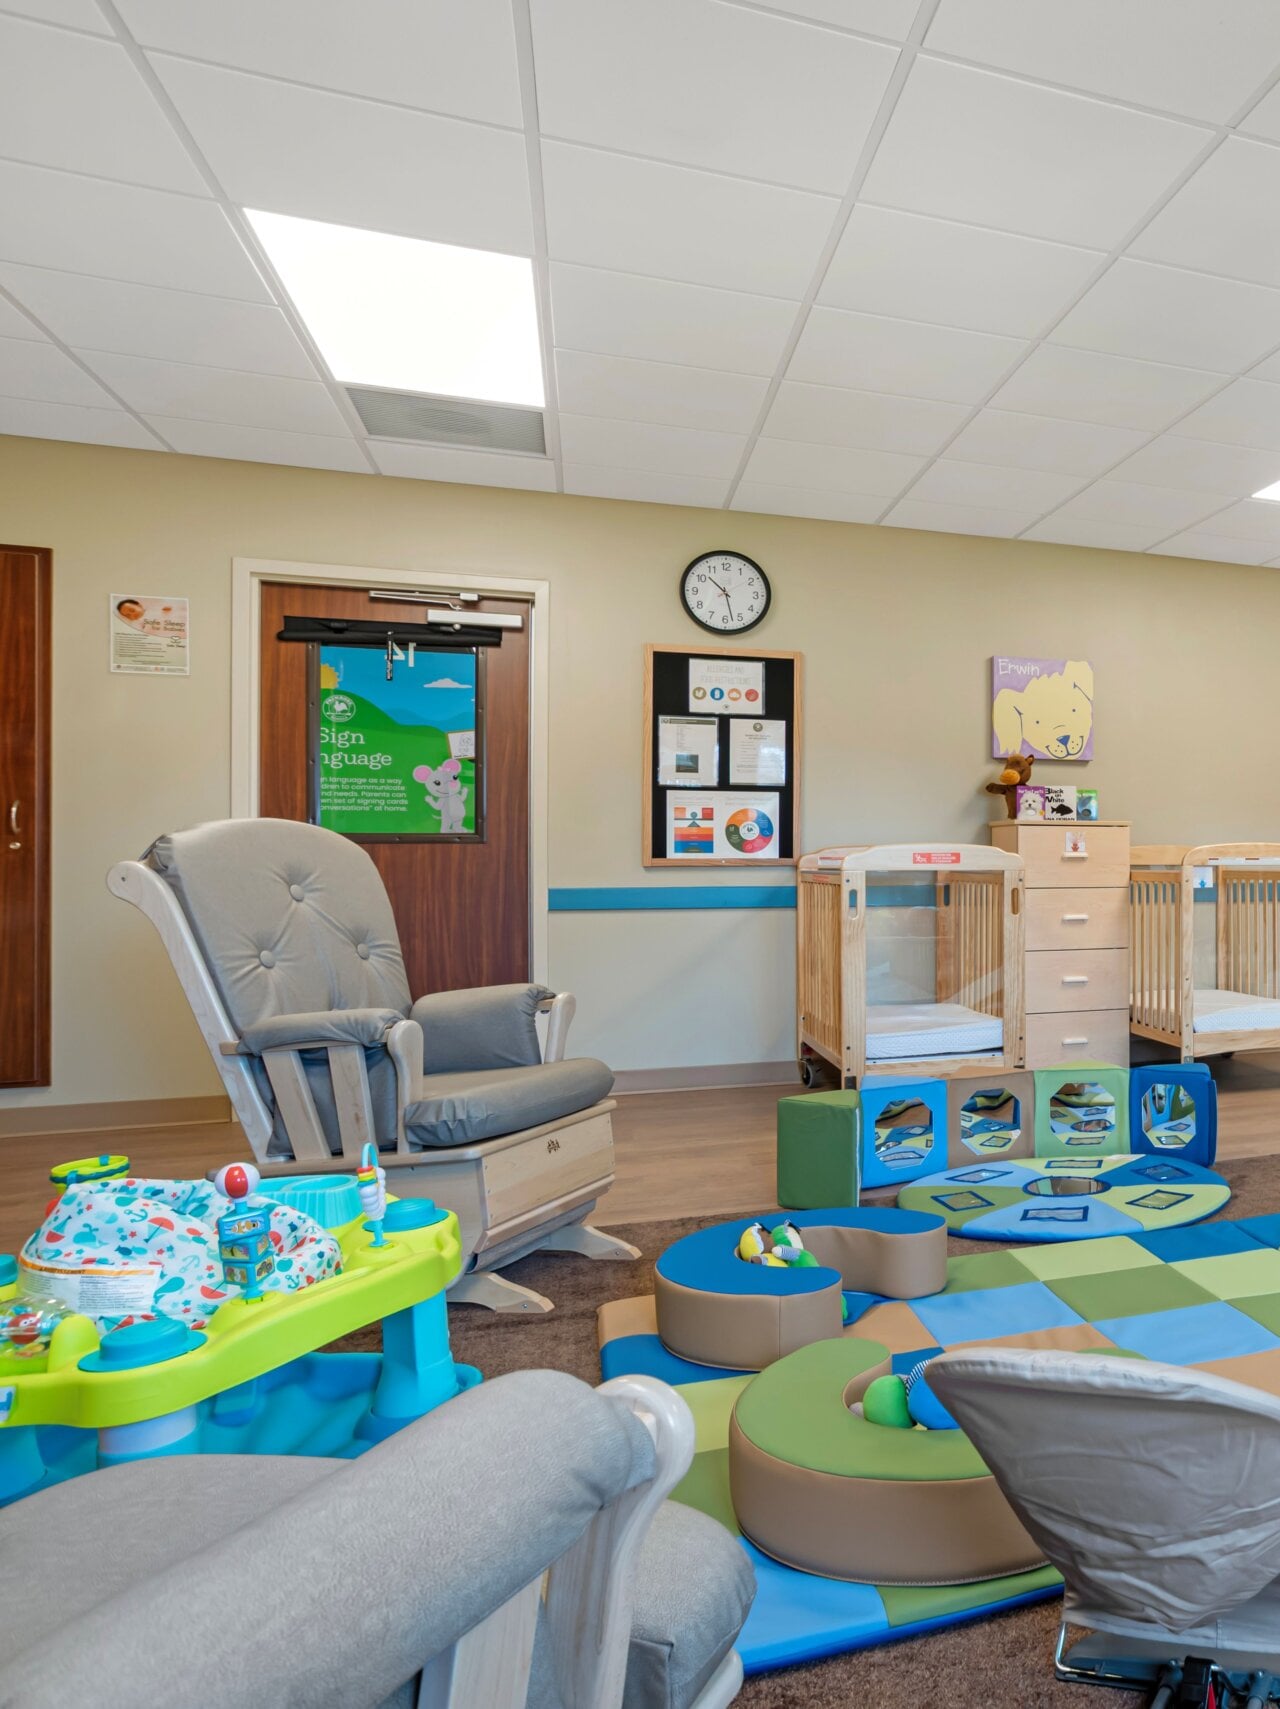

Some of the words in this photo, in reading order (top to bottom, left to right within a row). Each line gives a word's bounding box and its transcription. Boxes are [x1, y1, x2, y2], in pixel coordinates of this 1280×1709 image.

[708, 565, 716, 574] 11
[721, 562, 731, 572] 12
[738, 567, 742, 576] 1
[697, 573, 707, 583] 10
[747, 577, 755, 586] 2
[691, 586, 699, 596] 9
[752, 591, 759, 600] 3
[696, 600, 703, 609] 8
[747, 604, 754, 612] 4
[708, 610, 715, 620] 7
[721, 615, 729, 624] 6
[736, 612, 743, 622] 5
[998, 658, 1040, 677] Erwin
[320, 727, 365, 748] Sign
[329, 777, 367, 785] language
